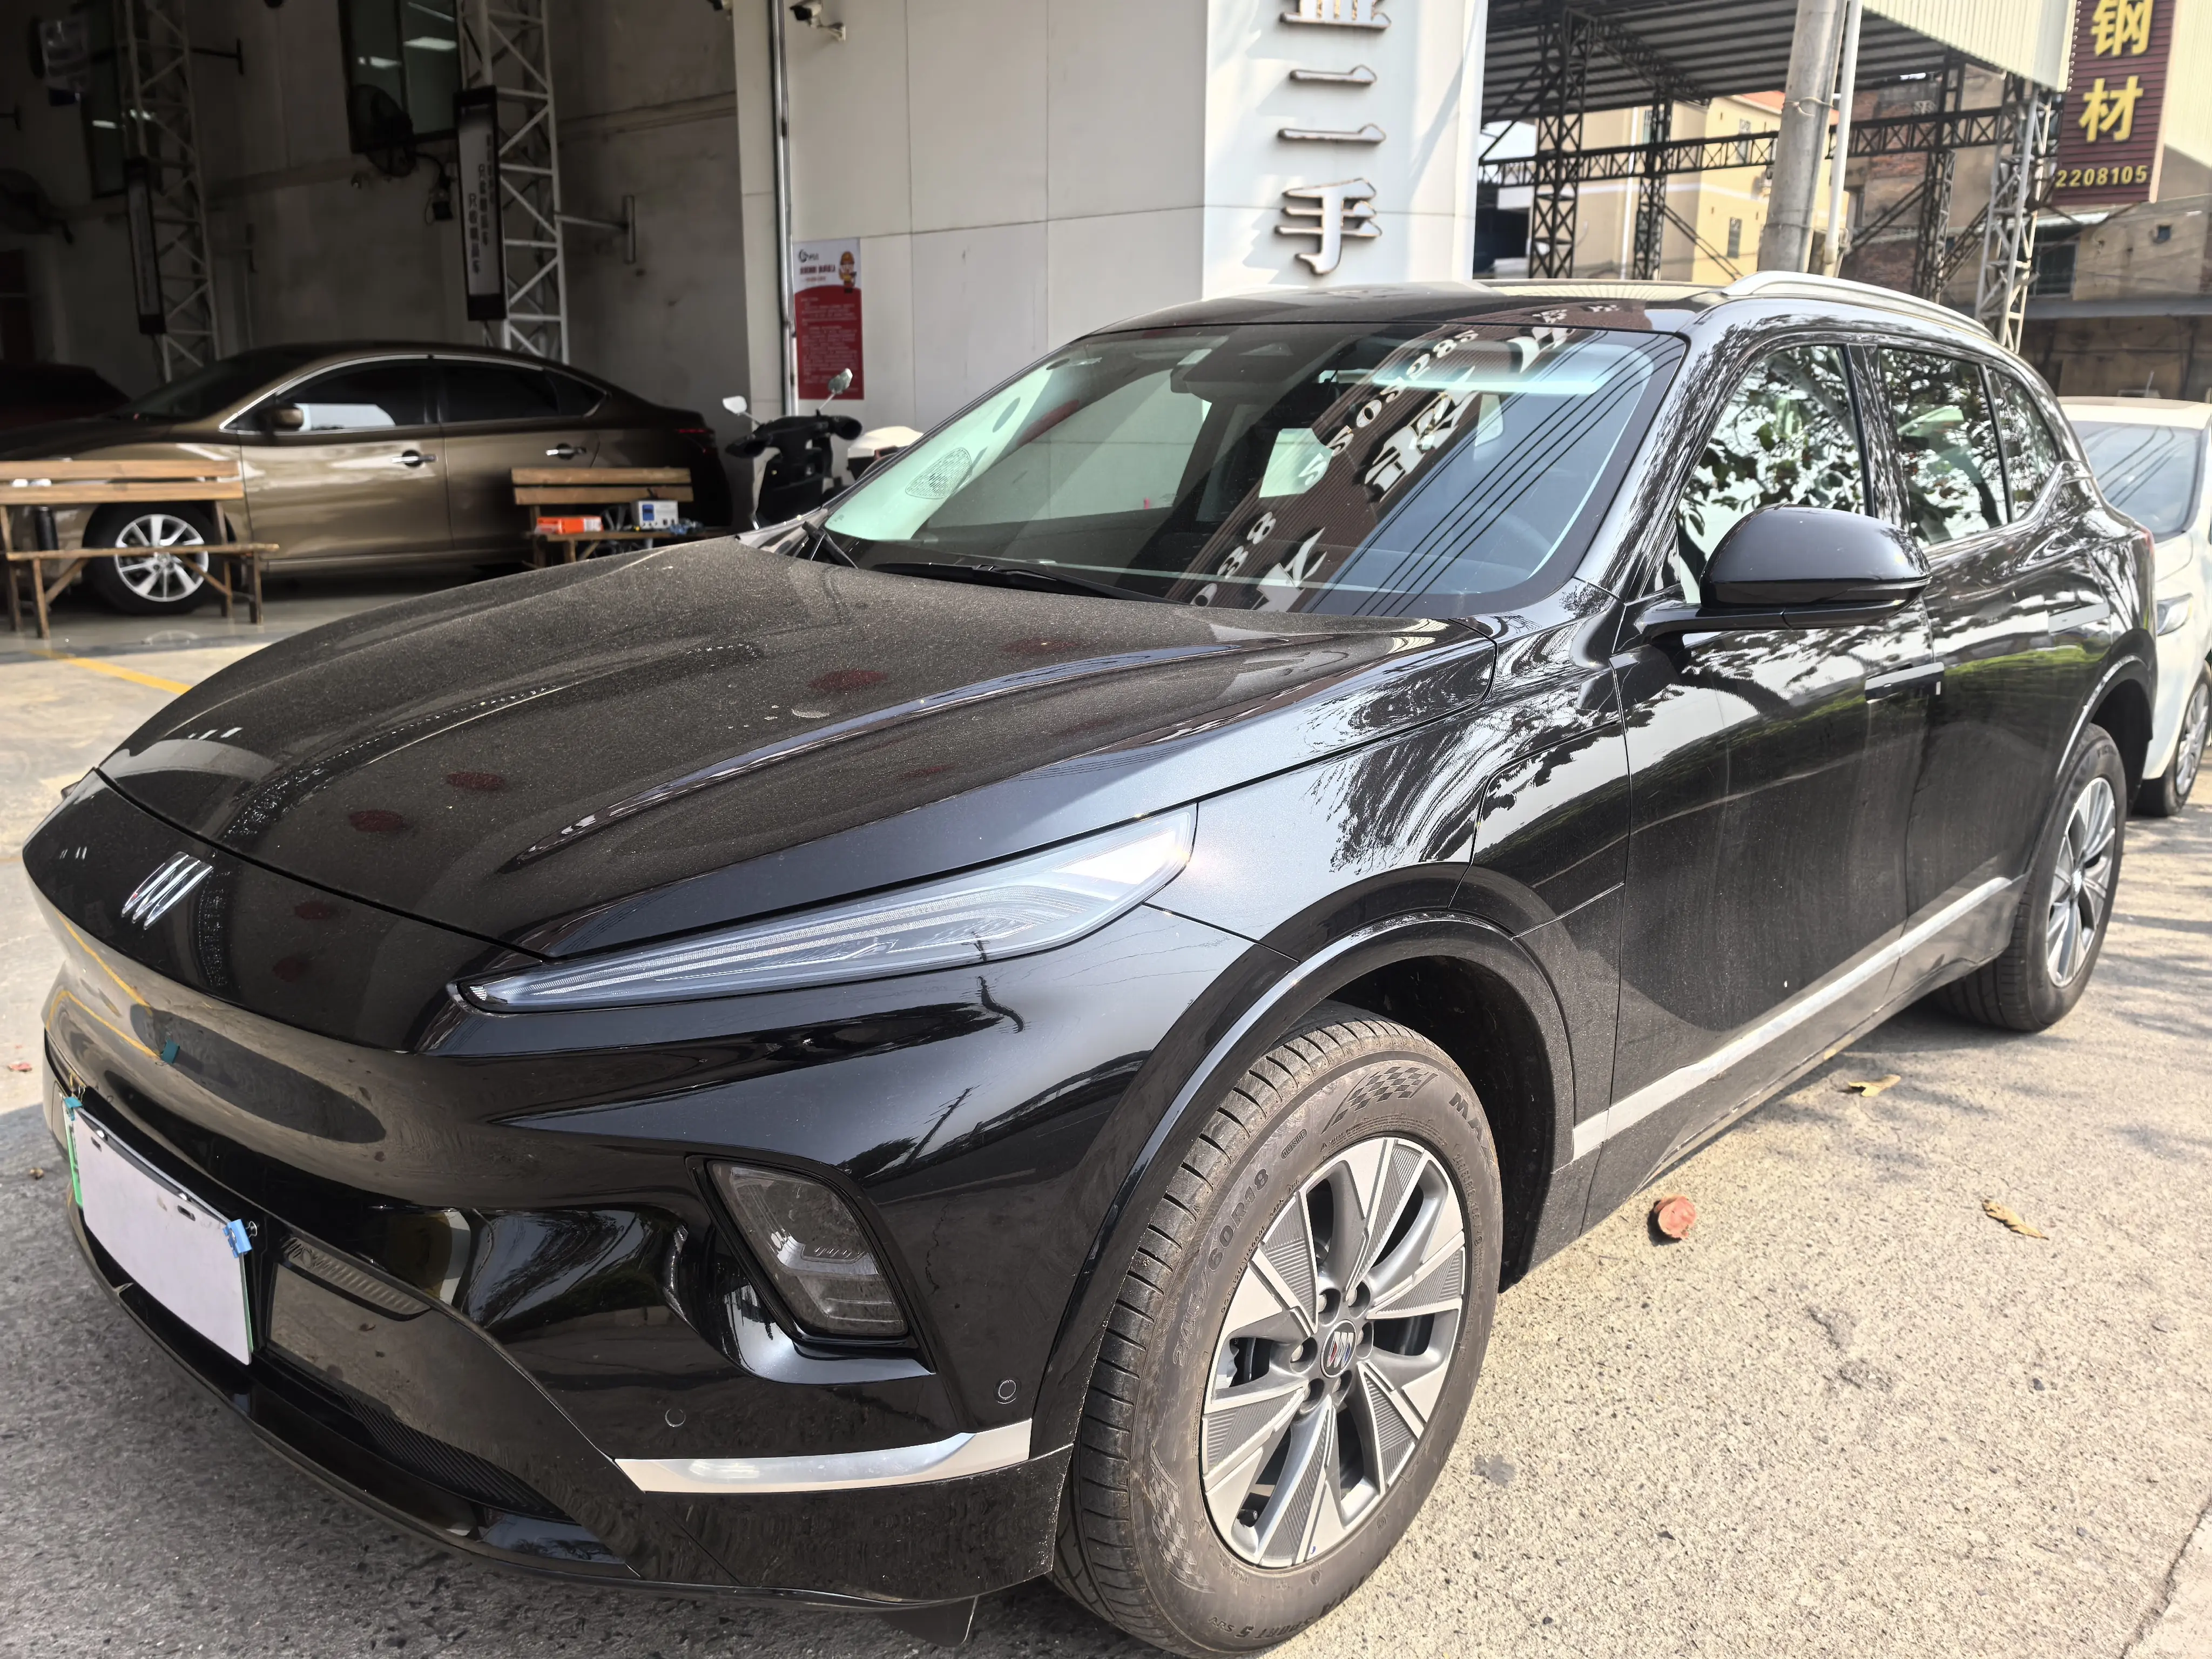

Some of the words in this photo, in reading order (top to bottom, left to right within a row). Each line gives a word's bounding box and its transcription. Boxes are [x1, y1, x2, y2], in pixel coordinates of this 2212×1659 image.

[1274, 0, 1391, 274] 二手
[2079, 0, 2154, 142] 钢材
[2055, 165, 2148, 187] 2208105
